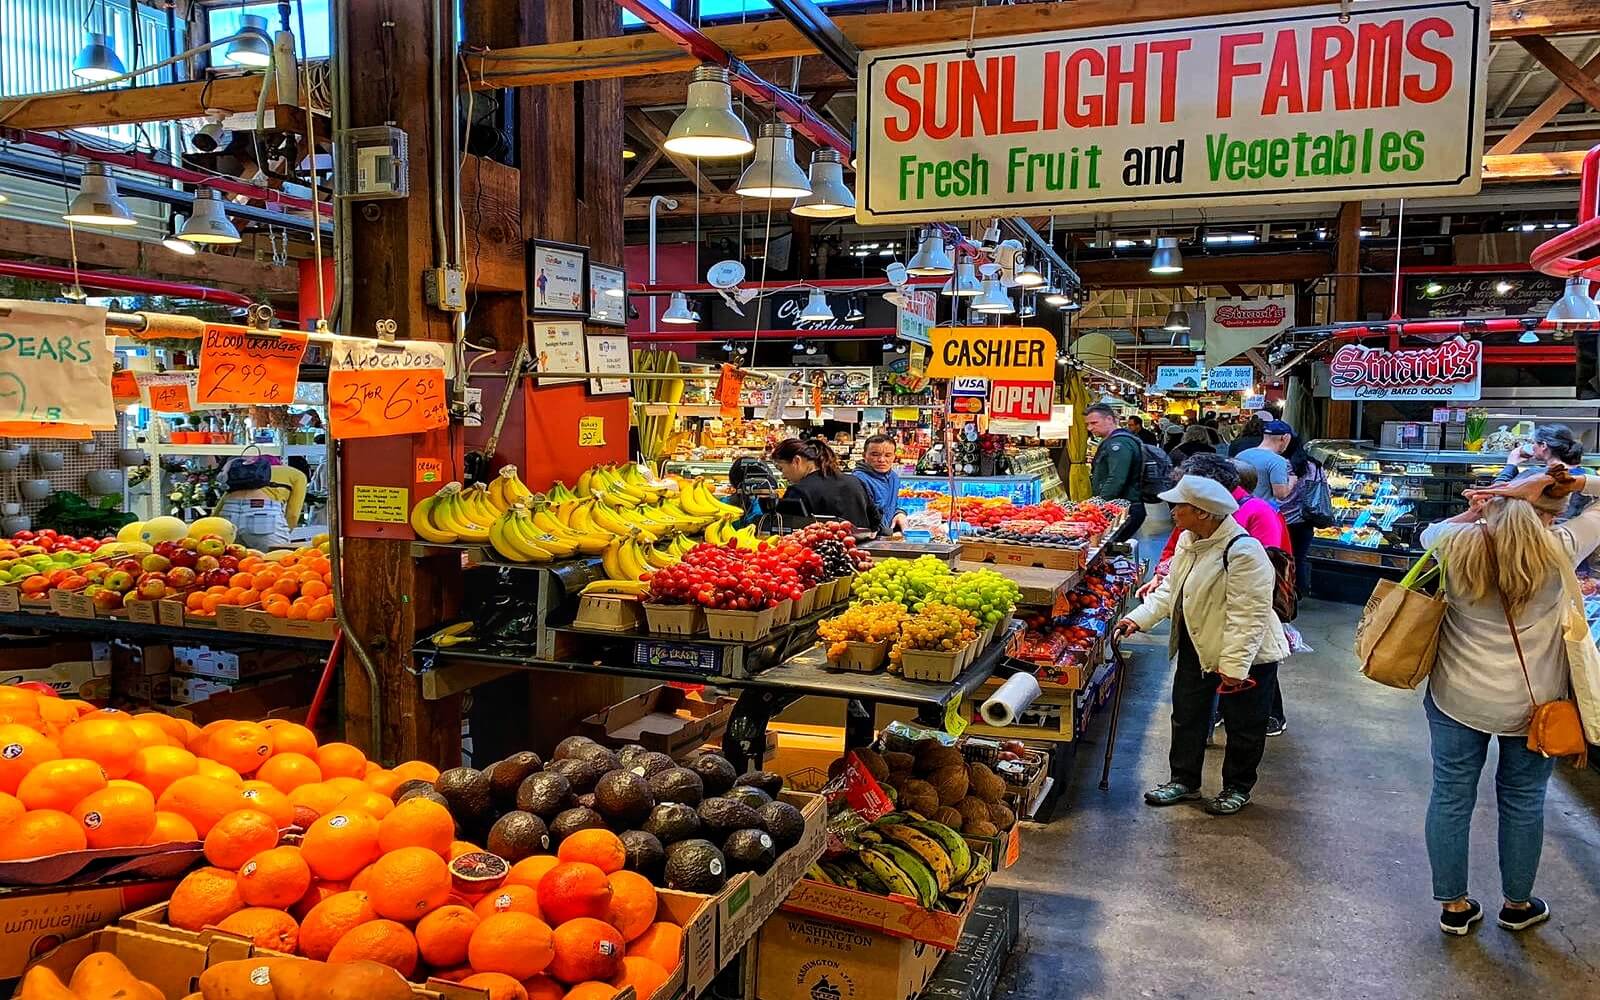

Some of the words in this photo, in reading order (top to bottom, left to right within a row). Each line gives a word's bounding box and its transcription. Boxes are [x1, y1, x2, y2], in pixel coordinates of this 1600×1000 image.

[883, 38, 1192, 142] SUNLIGHT
[1216, 17, 1454, 118] FARMS
[900, 153, 989, 200] Fresh
[1007, 145, 1102, 193] Fruit
[1122, 139, 1185, 186] and
[1206, 128, 1425, 181] Vegetables
[0, 333, 92, 363] PEARS
[207, 330, 243, 349] BLOOD
[943, 339, 1045, 368] CASHIER
[342, 350, 431, 369] AVOCADOS
[1331, 343, 1476, 387] Stuart's
[958, 379, 984, 388] VISA
[1210, 380, 1238, 389] Produce
[341, 383, 362, 421] 3
[993, 386, 1051, 415] OPEN
[5, 911, 102, 934] millennium
[787, 920, 872, 947] WASHINGTON
[806, 936, 852, 952] APPLES
